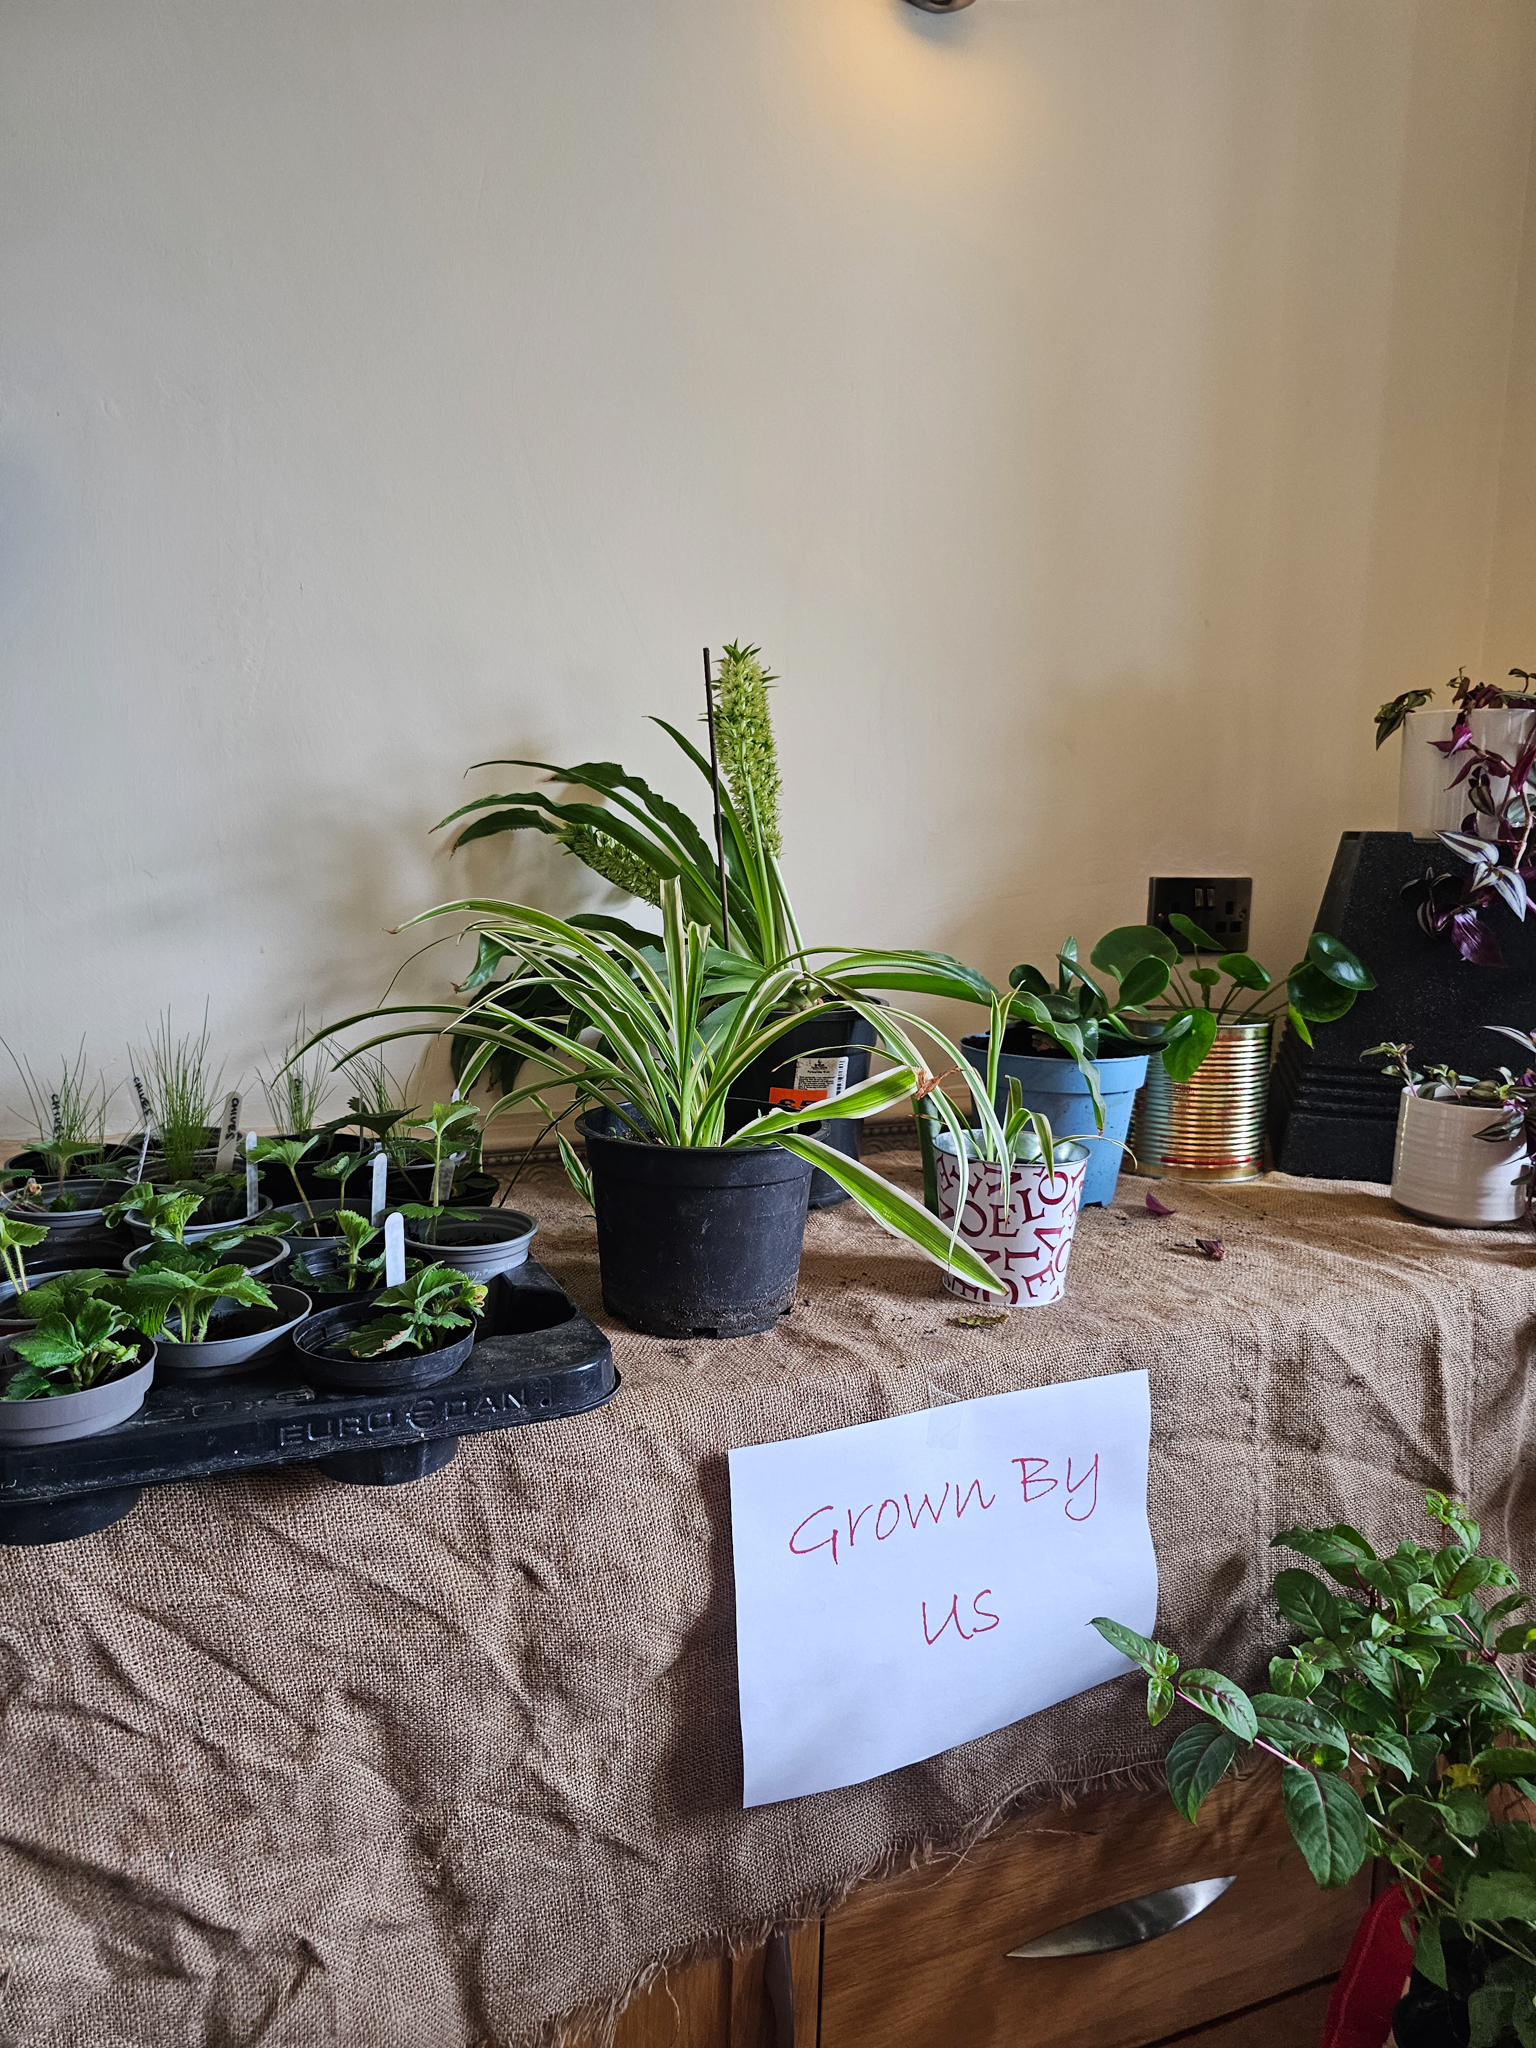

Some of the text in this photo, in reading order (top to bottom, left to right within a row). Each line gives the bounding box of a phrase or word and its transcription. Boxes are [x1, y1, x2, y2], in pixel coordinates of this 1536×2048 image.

[225, 1097, 240, 1141] CHIVES
[279, 1411, 395, 1446] EURO
[788, 1478, 996, 1565] Grown
